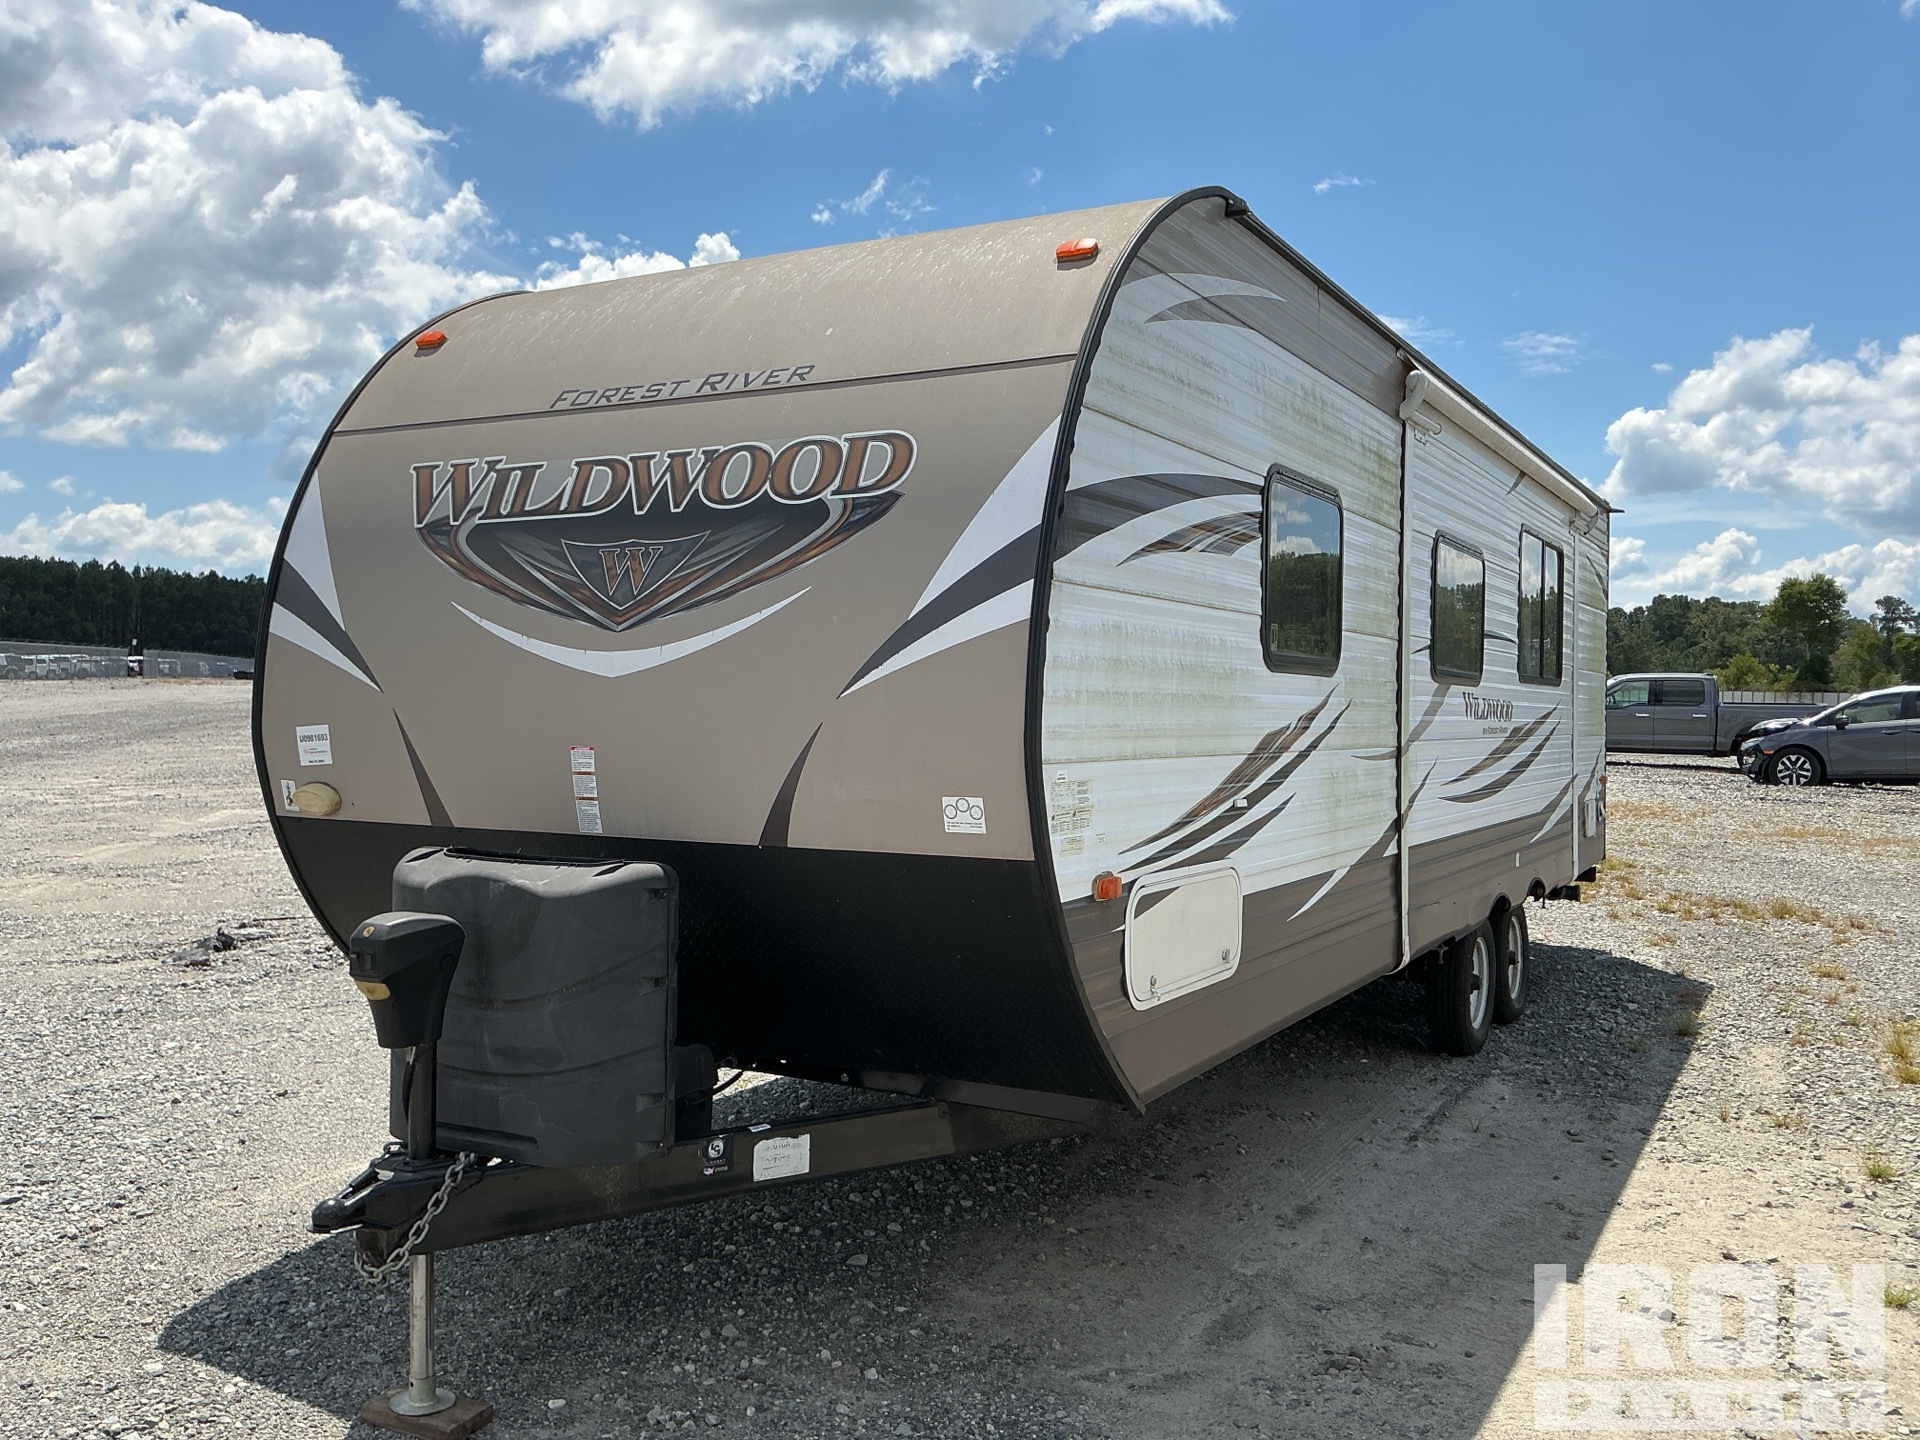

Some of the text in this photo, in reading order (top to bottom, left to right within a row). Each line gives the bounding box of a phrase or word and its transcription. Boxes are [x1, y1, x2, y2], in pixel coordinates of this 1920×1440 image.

[550, 364, 815, 409] FOREST RIVER
[411, 430, 917, 528] WILDWOOD
[599, 546, 663, 597] W
[1462, 692, 1514, 722] WILDWOOD
